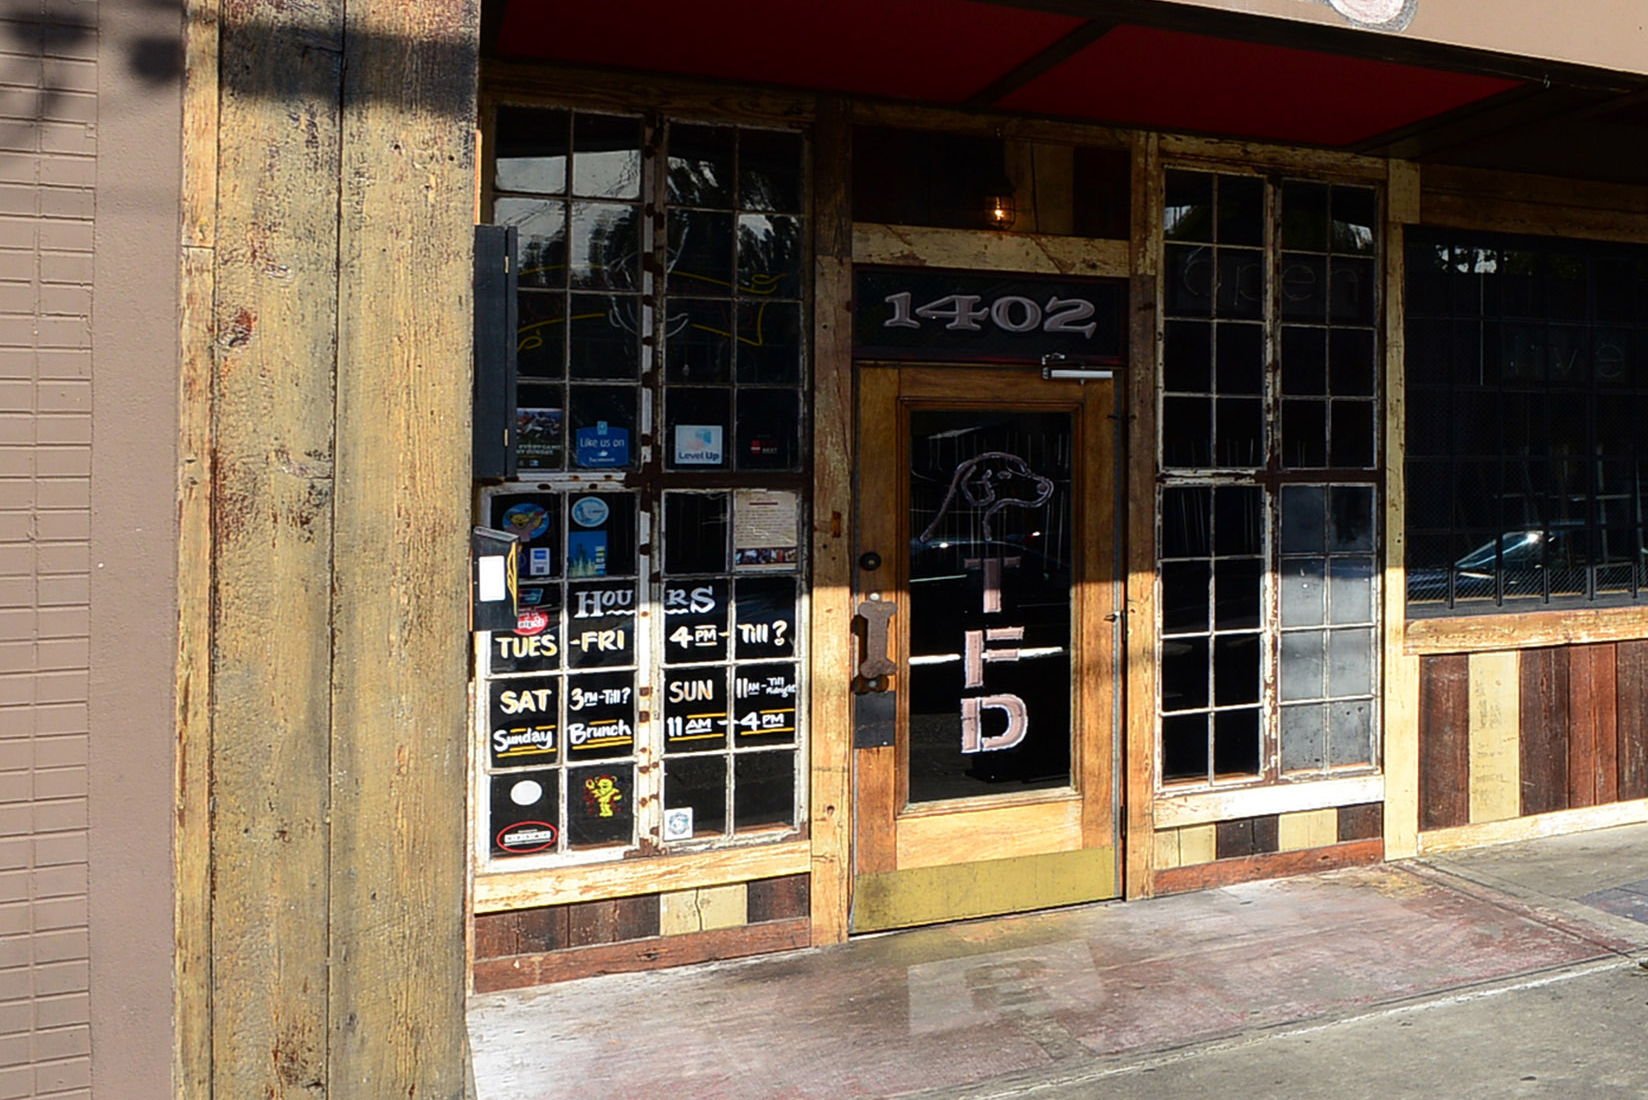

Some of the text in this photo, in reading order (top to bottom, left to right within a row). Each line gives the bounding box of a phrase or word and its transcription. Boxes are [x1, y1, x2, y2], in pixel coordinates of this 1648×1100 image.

[883, 291, 1097, 339] 1402
[579, 437, 625, 448] Like us on
[495, 635, 557, 659] TUES
[500, 688, 552, 715] SAT
[669, 679, 713, 703] SUN
[493, 728, 553, 752] Sunday
[568, 719, 632, 745] Brunch
